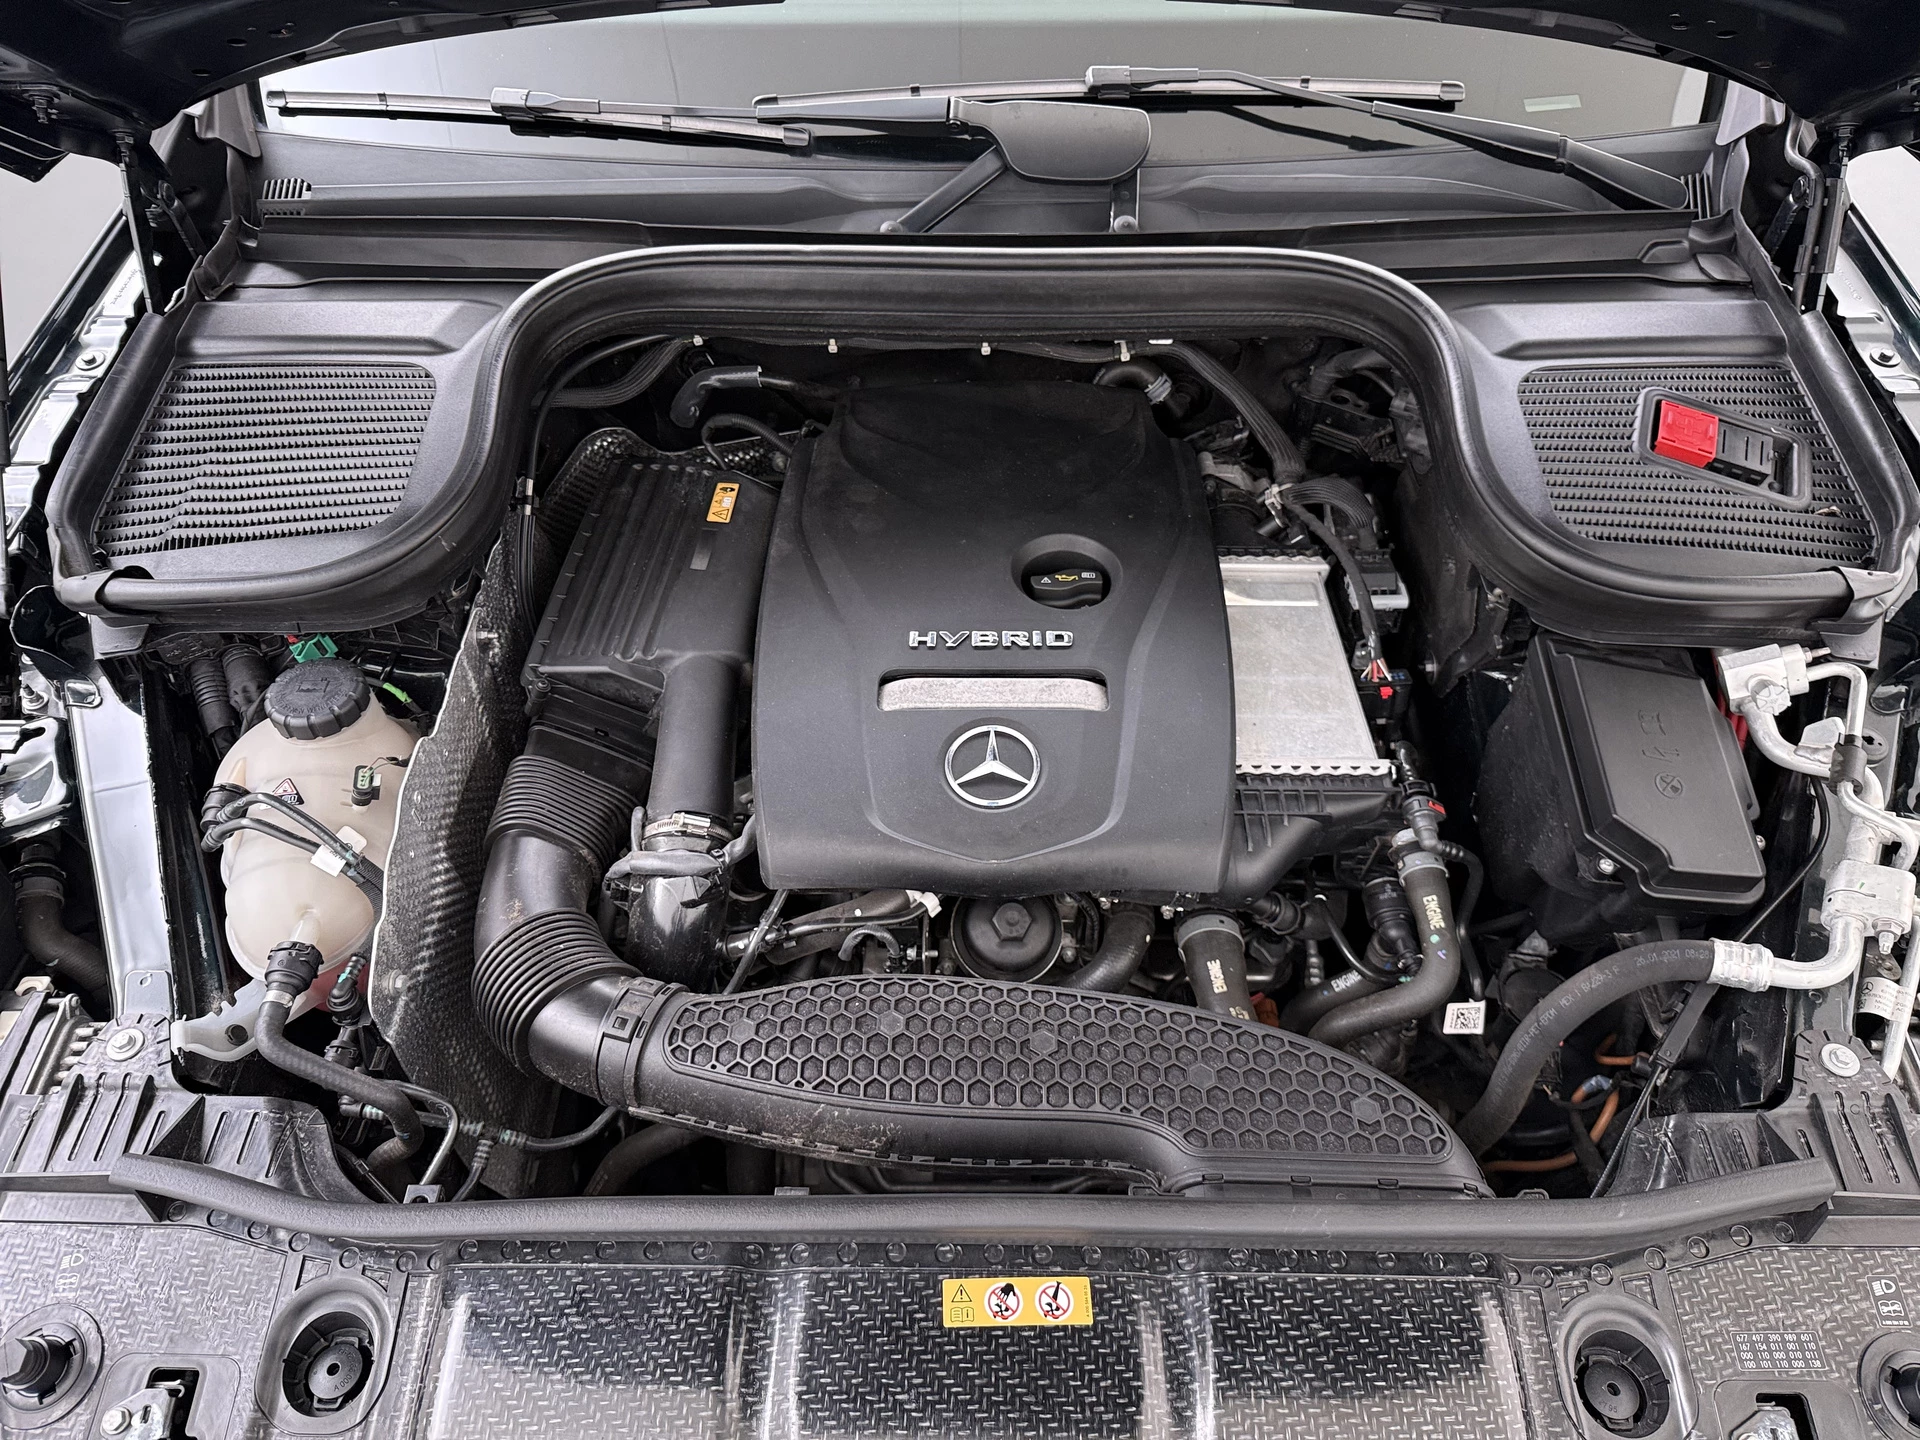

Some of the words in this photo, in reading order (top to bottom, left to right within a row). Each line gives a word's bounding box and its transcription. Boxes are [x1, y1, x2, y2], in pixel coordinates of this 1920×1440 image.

[909, 630, 1074, 647] HYBRID
[1423, 894, 1446, 931] ENGINE
[1207, 959, 1228, 993] ENGINE
[1736, 1334, 1748, 1342] 677
[1752, 1334, 1764, 1342] 497
[1768, 1334, 1781, 1342] 390
[1784, 1334, 1797, 1342] 989
[1800, 1334, 1813, 1342] 601
[1739, 1342, 1750, 1351] 167
[1770, 1342, 1783, 1351] 011
[1786, 1342, 1799, 1351] 001
[1803, 1342, 1816, 1351] 110
[1740, 1351, 1754, 1360] 000
[1757, 1351, 1770, 1360] 110
[1773, 1351, 1786, 1360] 000
[1789, 1351, 1802, 1360] 010
[1805, 1351, 1818, 1360] 011
[1743, 1360, 1756, 1368] 100
[1760, 1360, 1772, 1368] 101
[1776, 1360, 1789, 1368] 110
[1792, 1360, 1805, 1368] 000
[340, 1374, 352, 1387] 000
